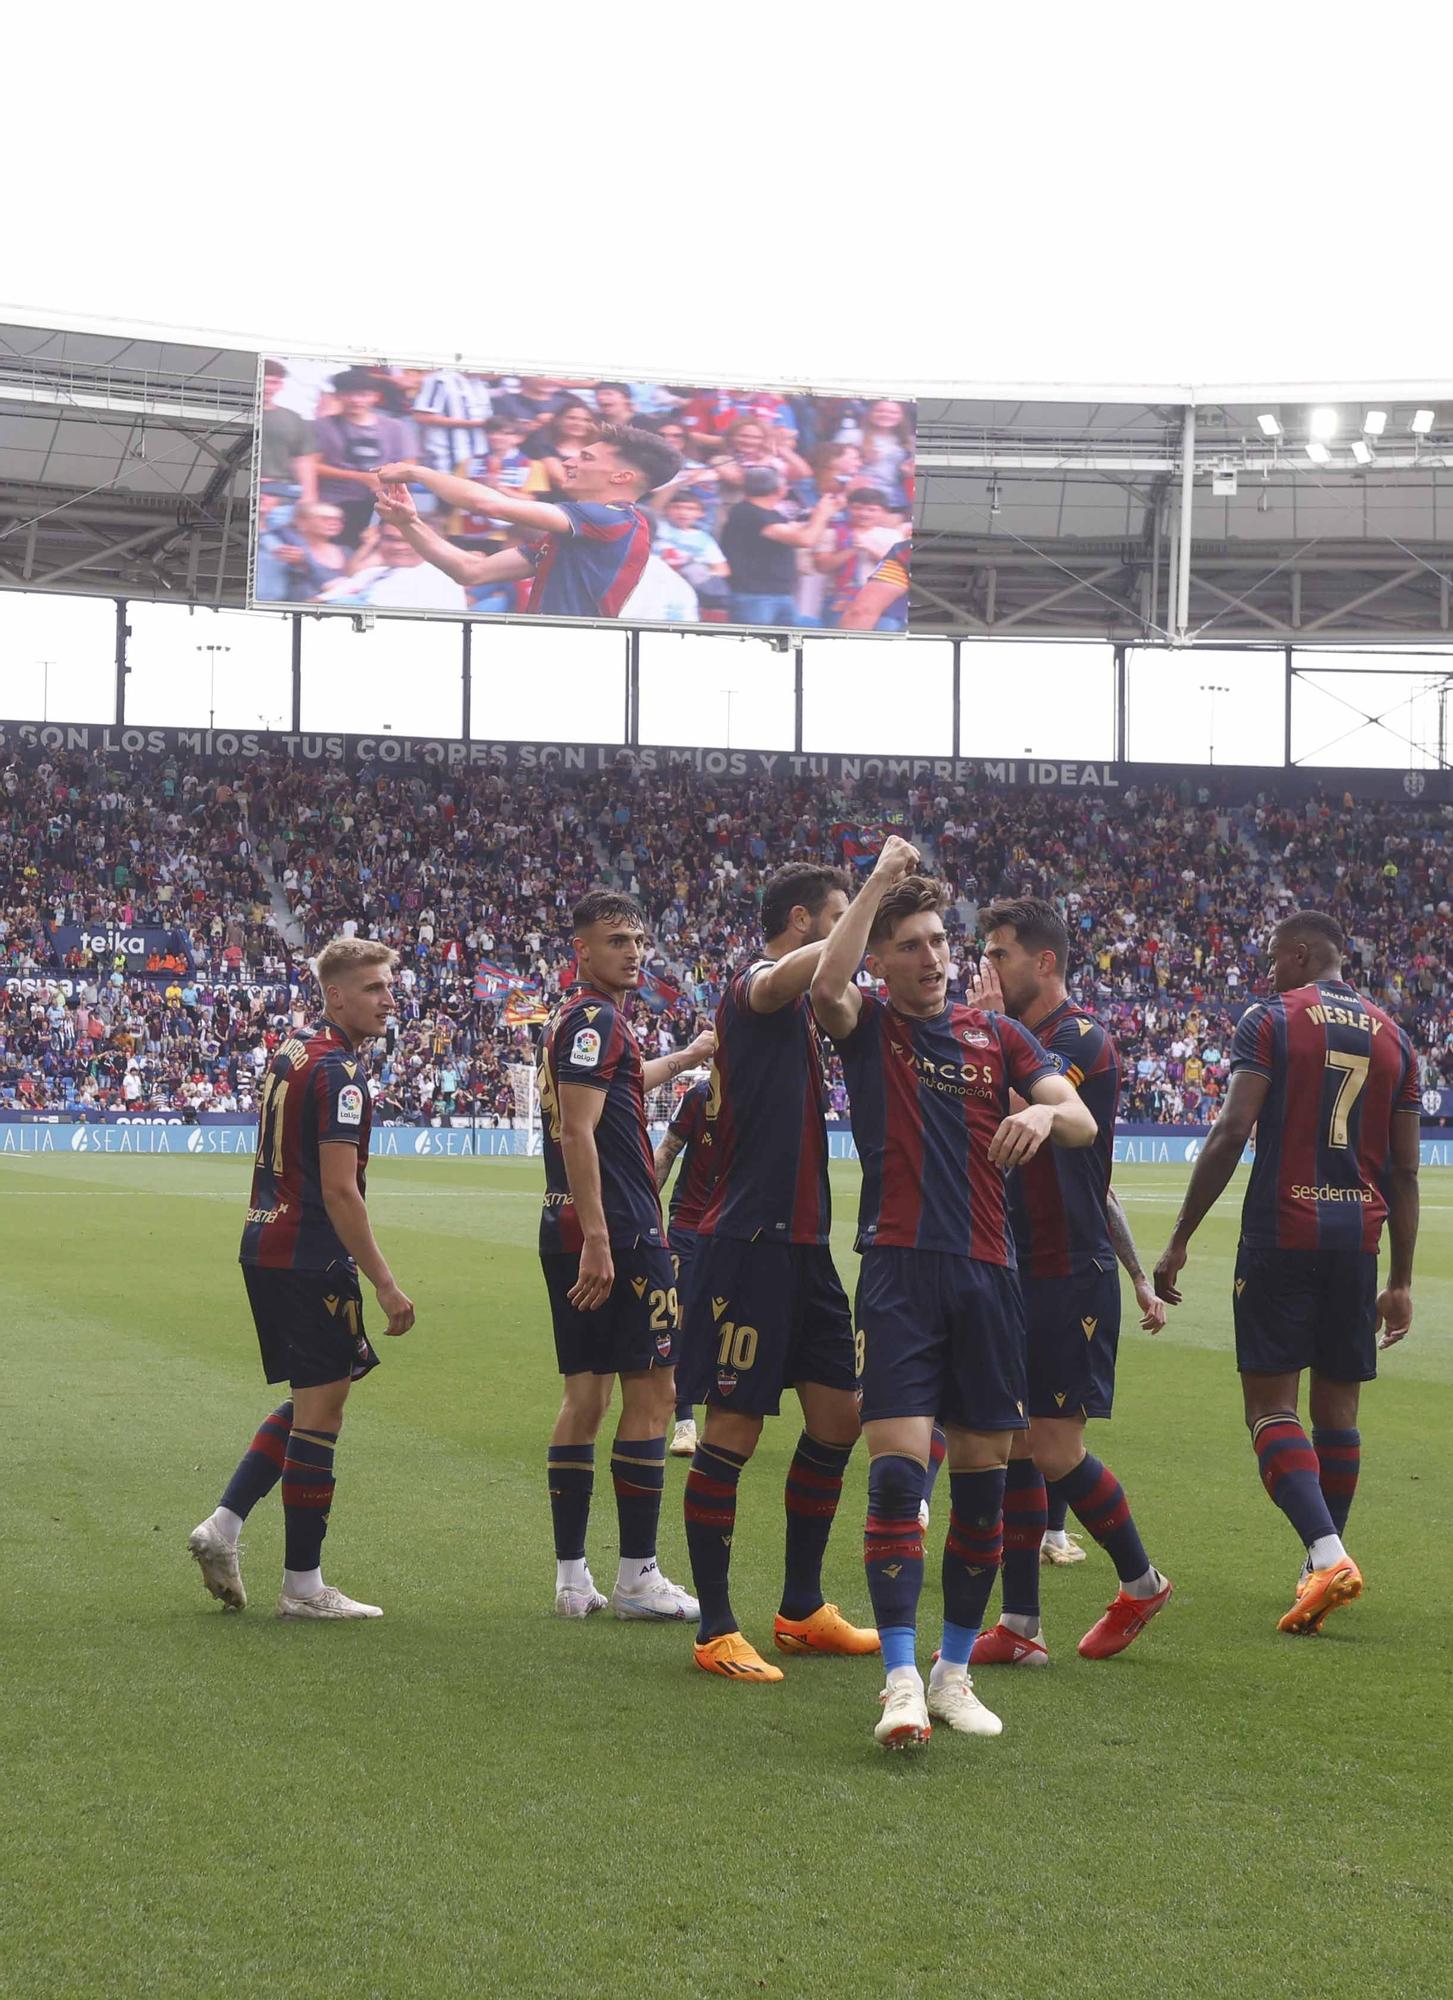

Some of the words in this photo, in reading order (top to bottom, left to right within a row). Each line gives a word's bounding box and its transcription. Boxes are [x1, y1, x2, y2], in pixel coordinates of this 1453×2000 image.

[19, 725, 89, 749] SON
[103, 729, 166, 753] LOS
[282, 736, 344, 760] TUS
[759, 755, 778, 776] Y
[789, 756, 829, 778] TU
[985, 762, 1016, 784] MI
[1029, 763, 1120, 787] IDEAL
[80, 932, 145, 954] teika
[1306, 1004, 1384, 1036] WESLEY
[573, 1052, 596, 1062] LaLiga
[1325, 1050, 1370, 1150] 7
[92, 1129, 170, 1153] SEALIA
[1291, 1183, 1373, 1203] sesderma
[648, 1286, 679, 1331] 29
[717, 1321, 759, 1372] 10
